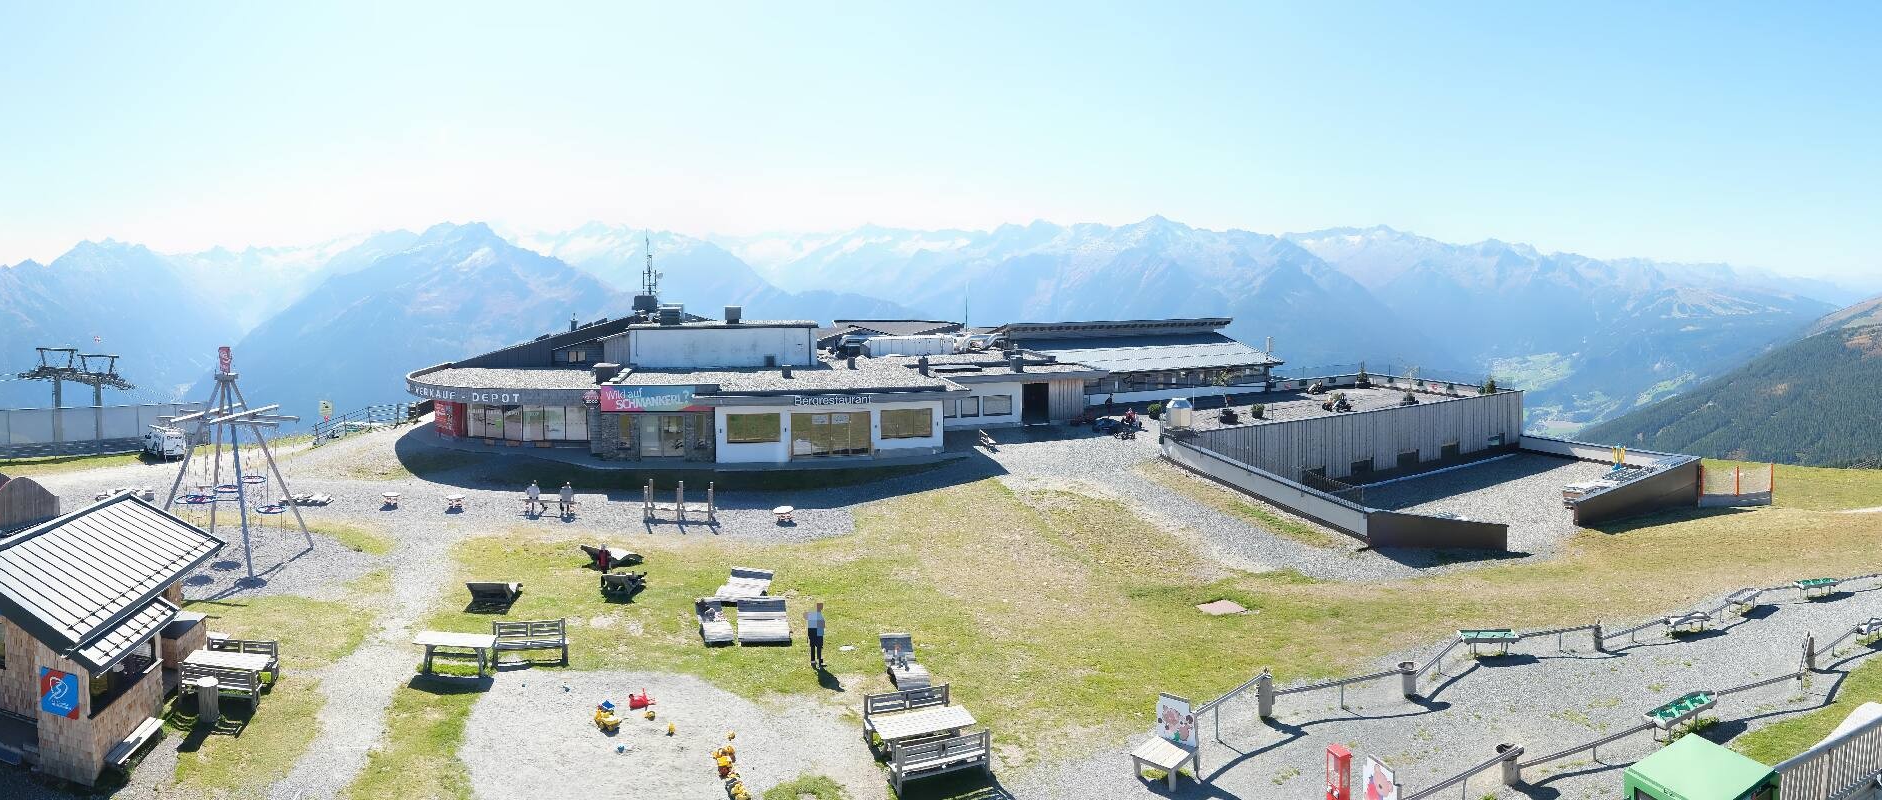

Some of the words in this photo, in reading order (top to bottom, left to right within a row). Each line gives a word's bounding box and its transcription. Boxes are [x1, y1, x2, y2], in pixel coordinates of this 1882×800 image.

[414, 385, 456, 400] VERKAUF
[472, 392, 520, 403] DEPOT
[605, 389, 626, 400] Wild
[627, 387, 643, 398] auf
[794, 395, 872, 406] Bergrestaurant
